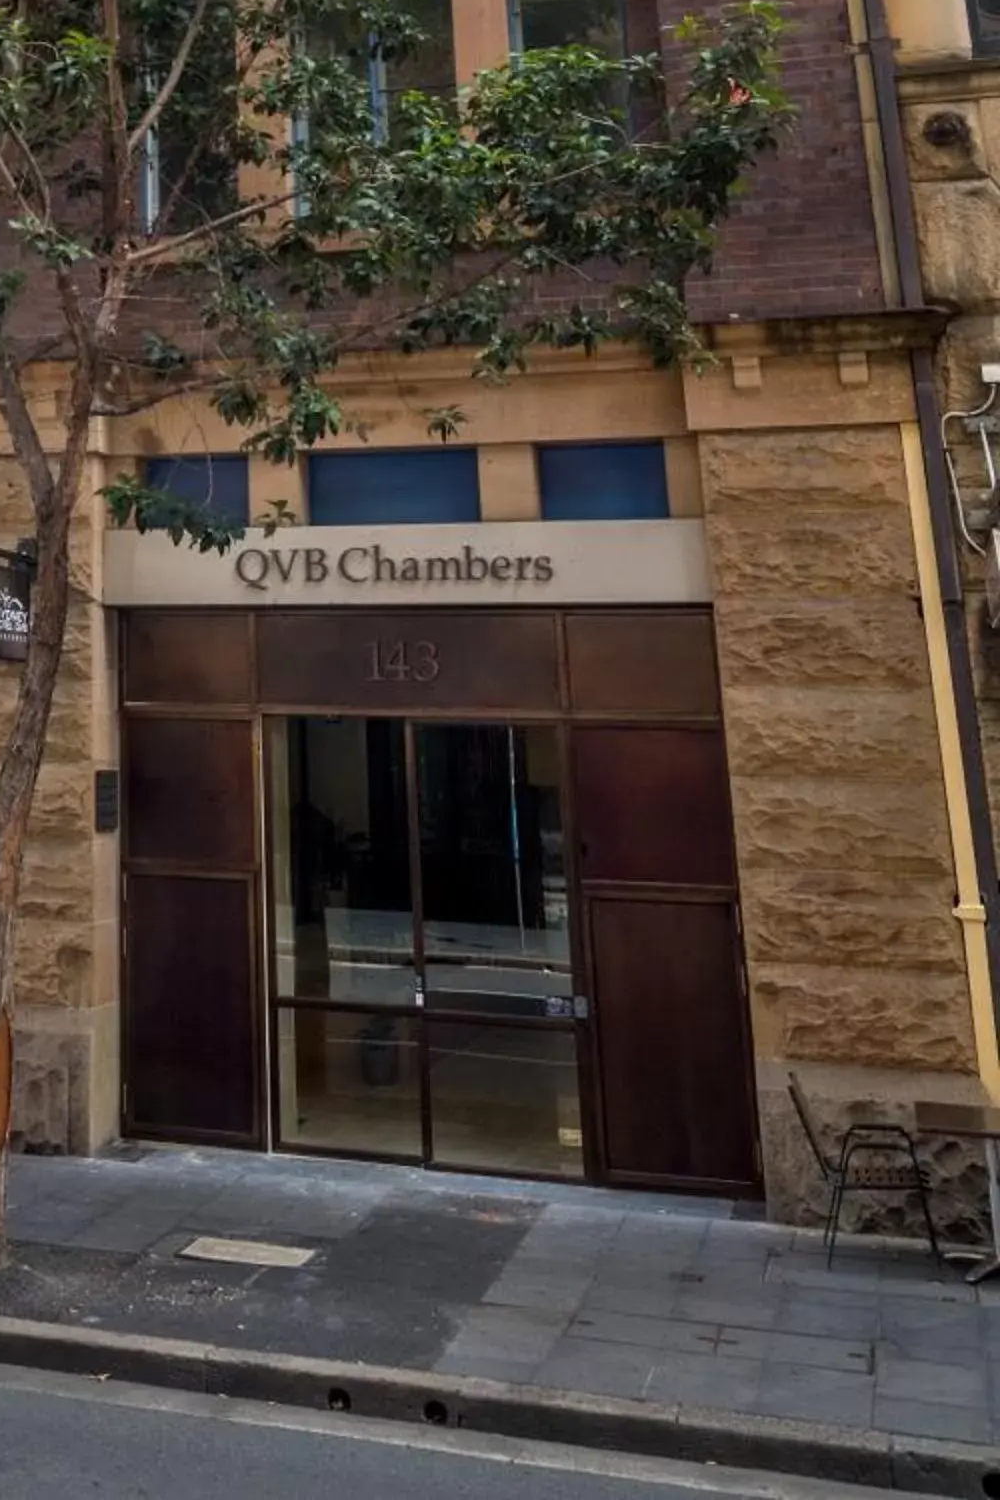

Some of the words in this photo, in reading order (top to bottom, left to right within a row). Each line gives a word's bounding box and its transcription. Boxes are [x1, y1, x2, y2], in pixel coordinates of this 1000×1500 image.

[235, 548, 329, 590] QVB
[336, 545, 555, 584] Chambers
[363, 641, 440, 683] 143
